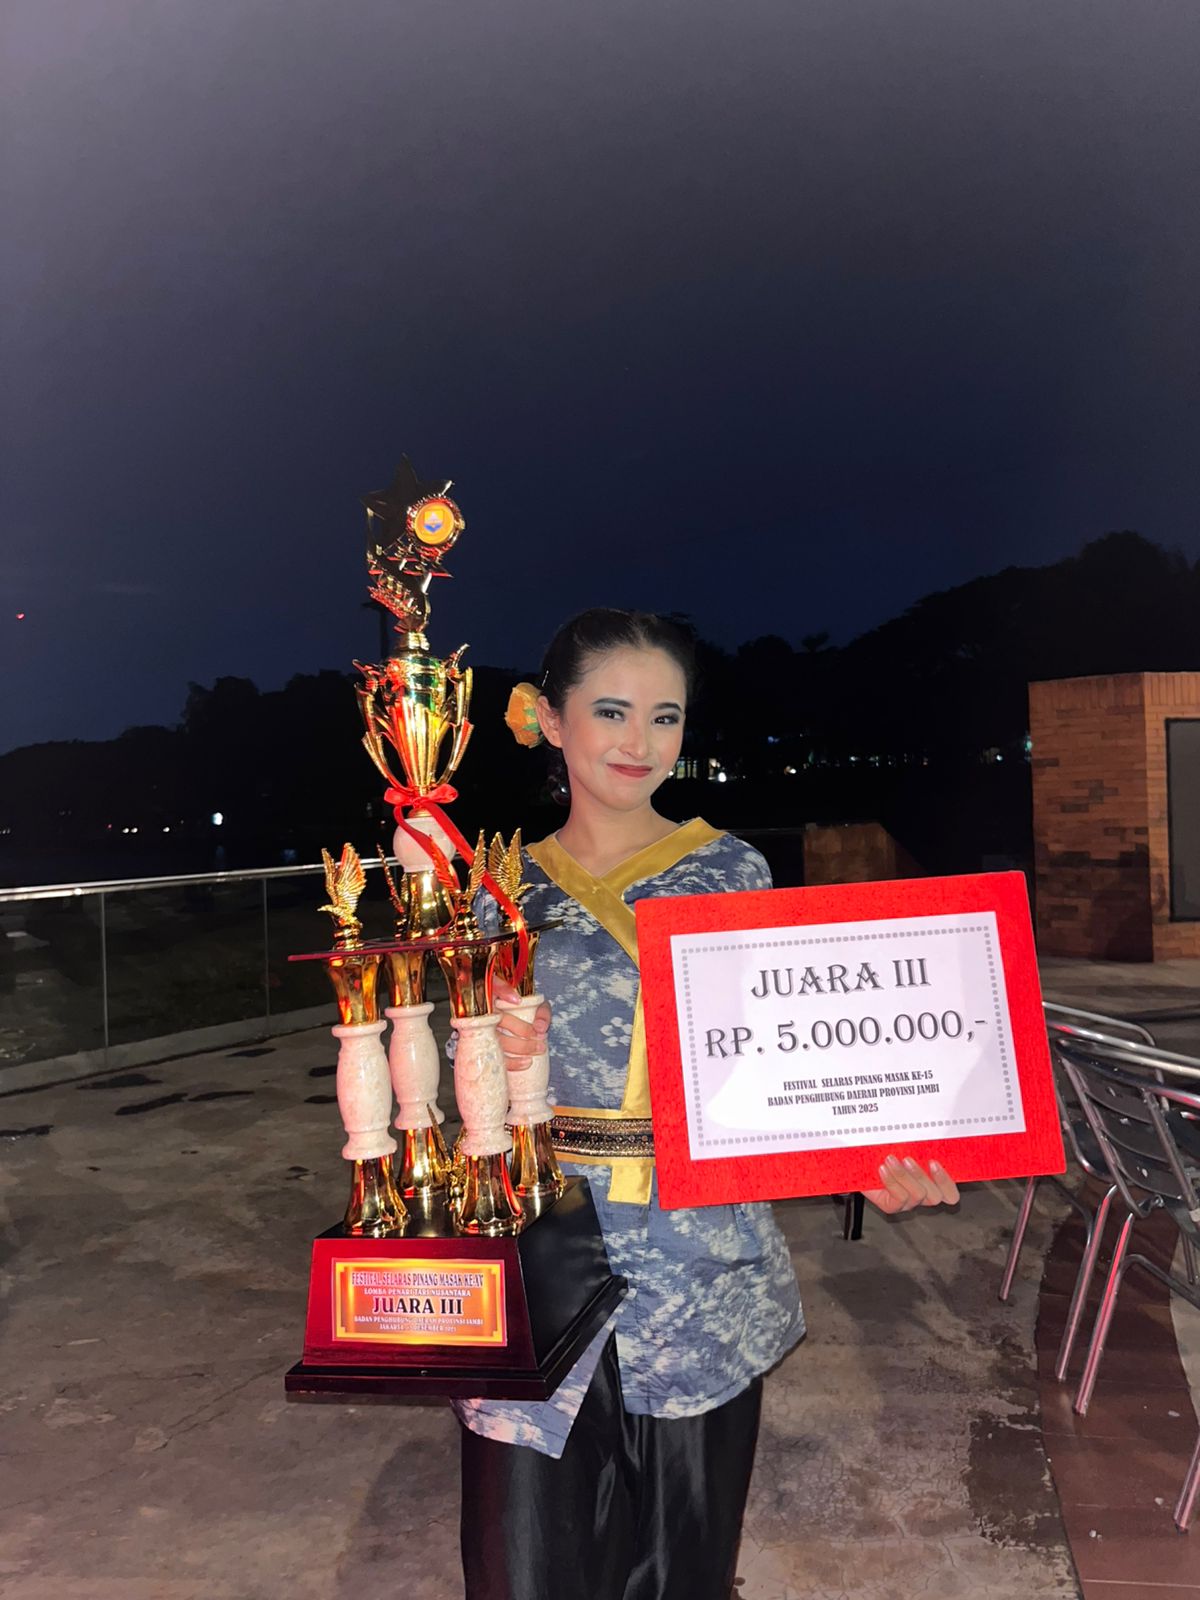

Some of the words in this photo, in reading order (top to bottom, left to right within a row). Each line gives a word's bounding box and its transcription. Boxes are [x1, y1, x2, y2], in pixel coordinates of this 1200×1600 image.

[751, 962, 884, 999] JUARA
[892, 958, 932, 988] III
[705, 1027, 764, 1059] RP.
[777, 1010, 988, 1053] 5.000.000,-
[783, 1079, 817, 1091] FESTIVAL
[821, 1076, 853, 1088] SELARAS
[854, 1074, 883, 1085] PINANG
[884, 1071, 910, 1082] MASAK
[911, 1069, 934, 1080] KE-15
[767, 1095, 794, 1107] BADAN
[795, 1091, 845, 1105] PENGHUBUNG
[846, 1088, 878, 1100] DAERAH
[879, 1085, 916, 1098] PROVINSI
[917, 1083, 940, 1095] JAMBI
[832, 1104, 857, 1116] TAHUN
[858, 1102, 879, 1114] 2025
[352, 1272, 380, 1286] FESTIVAL
[382, 1272, 411, 1286] SELARAS
[412, 1273, 438, 1287] PINANG
[439, 1273, 463, 1287] MASAK
[364, 1287, 387, 1295] LOMBA
[388, 1288, 412, 1297] PENARI
[431, 1289, 472, 1297] NUSANTARA
[373, 1297, 434, 1314] JUARA
[440, 1298, 463, 1315] III
